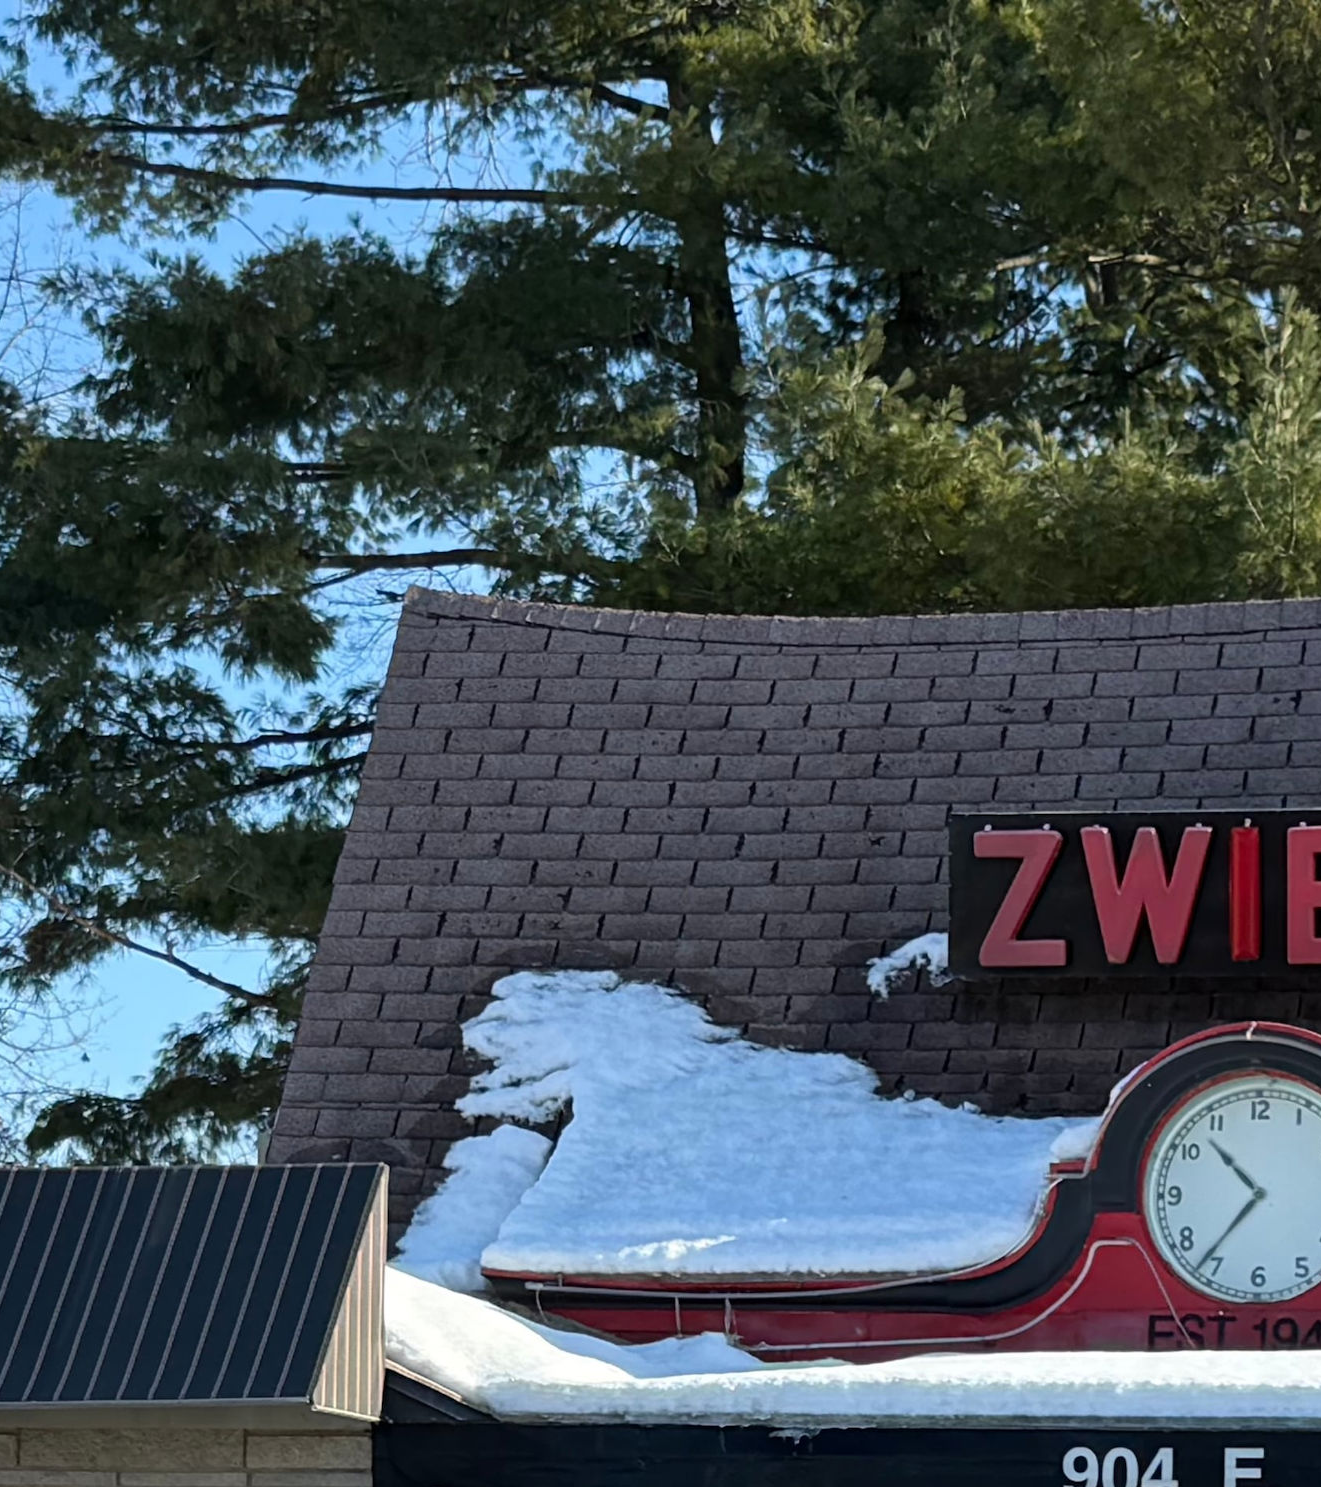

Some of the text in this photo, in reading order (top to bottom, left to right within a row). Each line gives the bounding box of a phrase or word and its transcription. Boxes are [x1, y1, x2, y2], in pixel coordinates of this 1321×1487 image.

[1250, 1099, 1271, 1121] 12
[1295, 1107, 1303, 1126] 1
[1209, 1113, 1224, 1132] 11
[1181, 1142, 1201, 1161] 10
[1166, 1185, 1183, 1207] 9
[1178, 1225, 1195, 1252] 8
[1209, 1256, 1225, 1278] 7
[1249, 1266, 1267, 1288] 6
[1293, 1256, 1310, 1279] 5
[1147, 1313, 1238, 1351] EST
